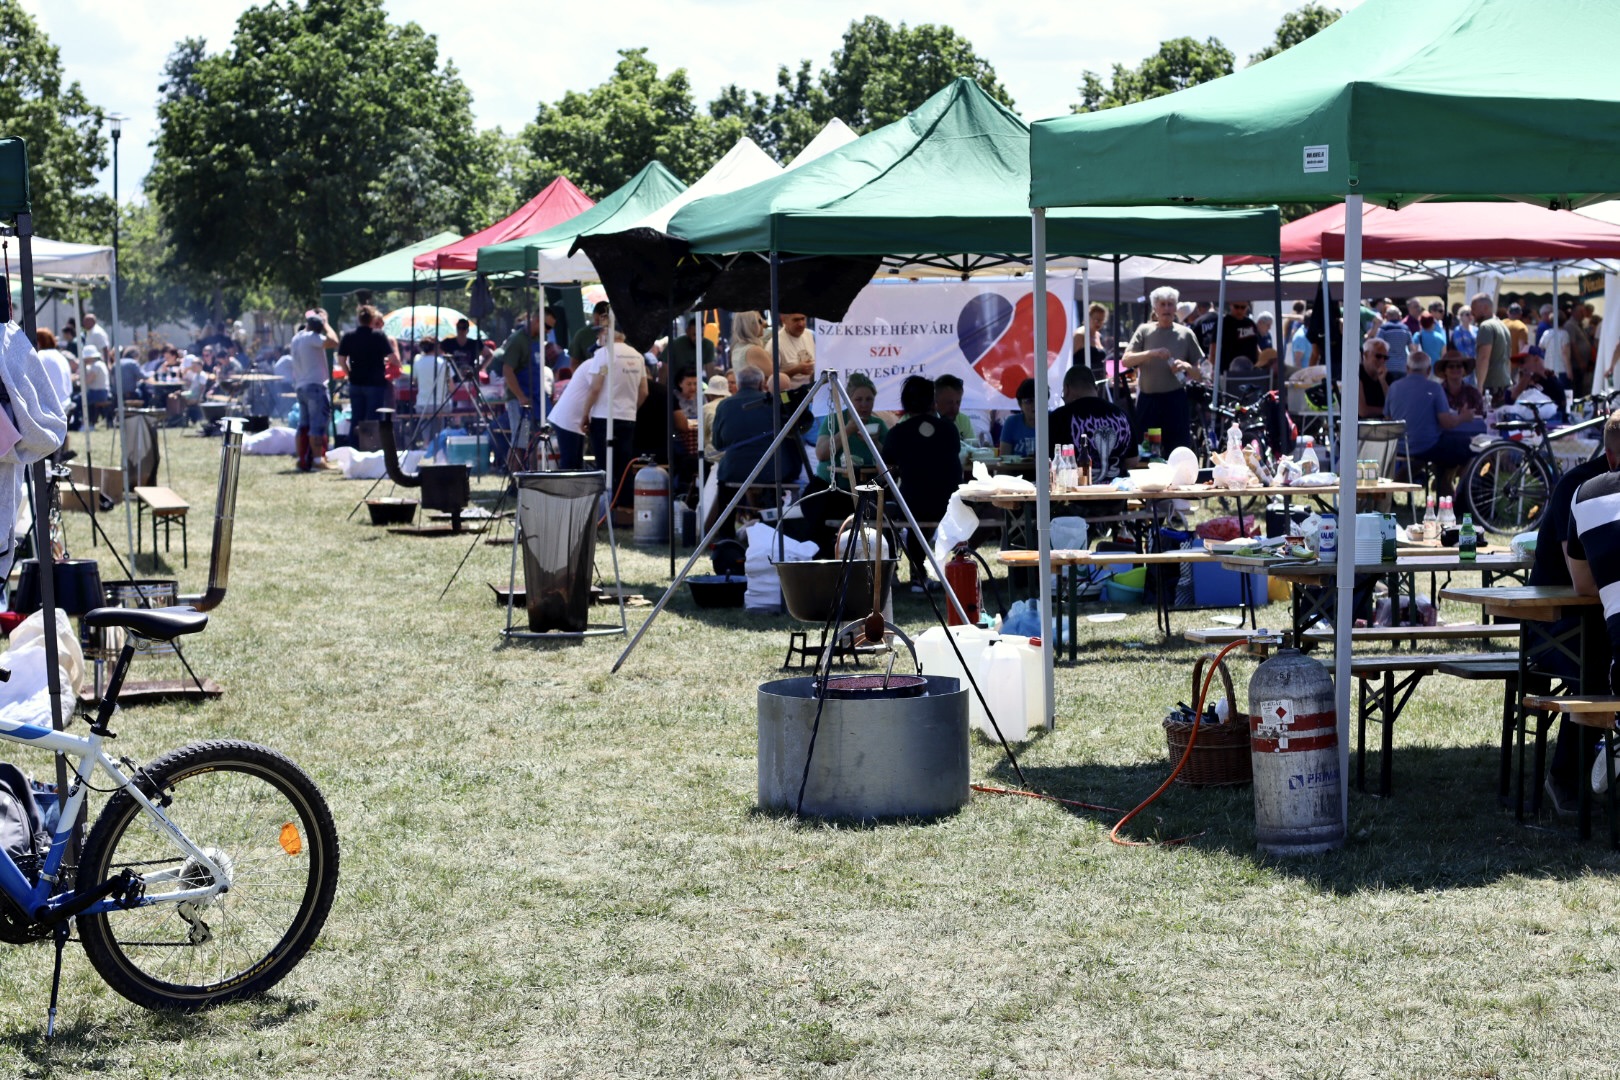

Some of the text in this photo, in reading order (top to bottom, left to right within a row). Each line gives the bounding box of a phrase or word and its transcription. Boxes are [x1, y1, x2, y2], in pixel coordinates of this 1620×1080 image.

[818, 321, 954, 336] SZÉKESFEHÉRVÁRI
[870, 344, 902, 357] SZÍV
[206, 956, 274, 992] WARRIOR
